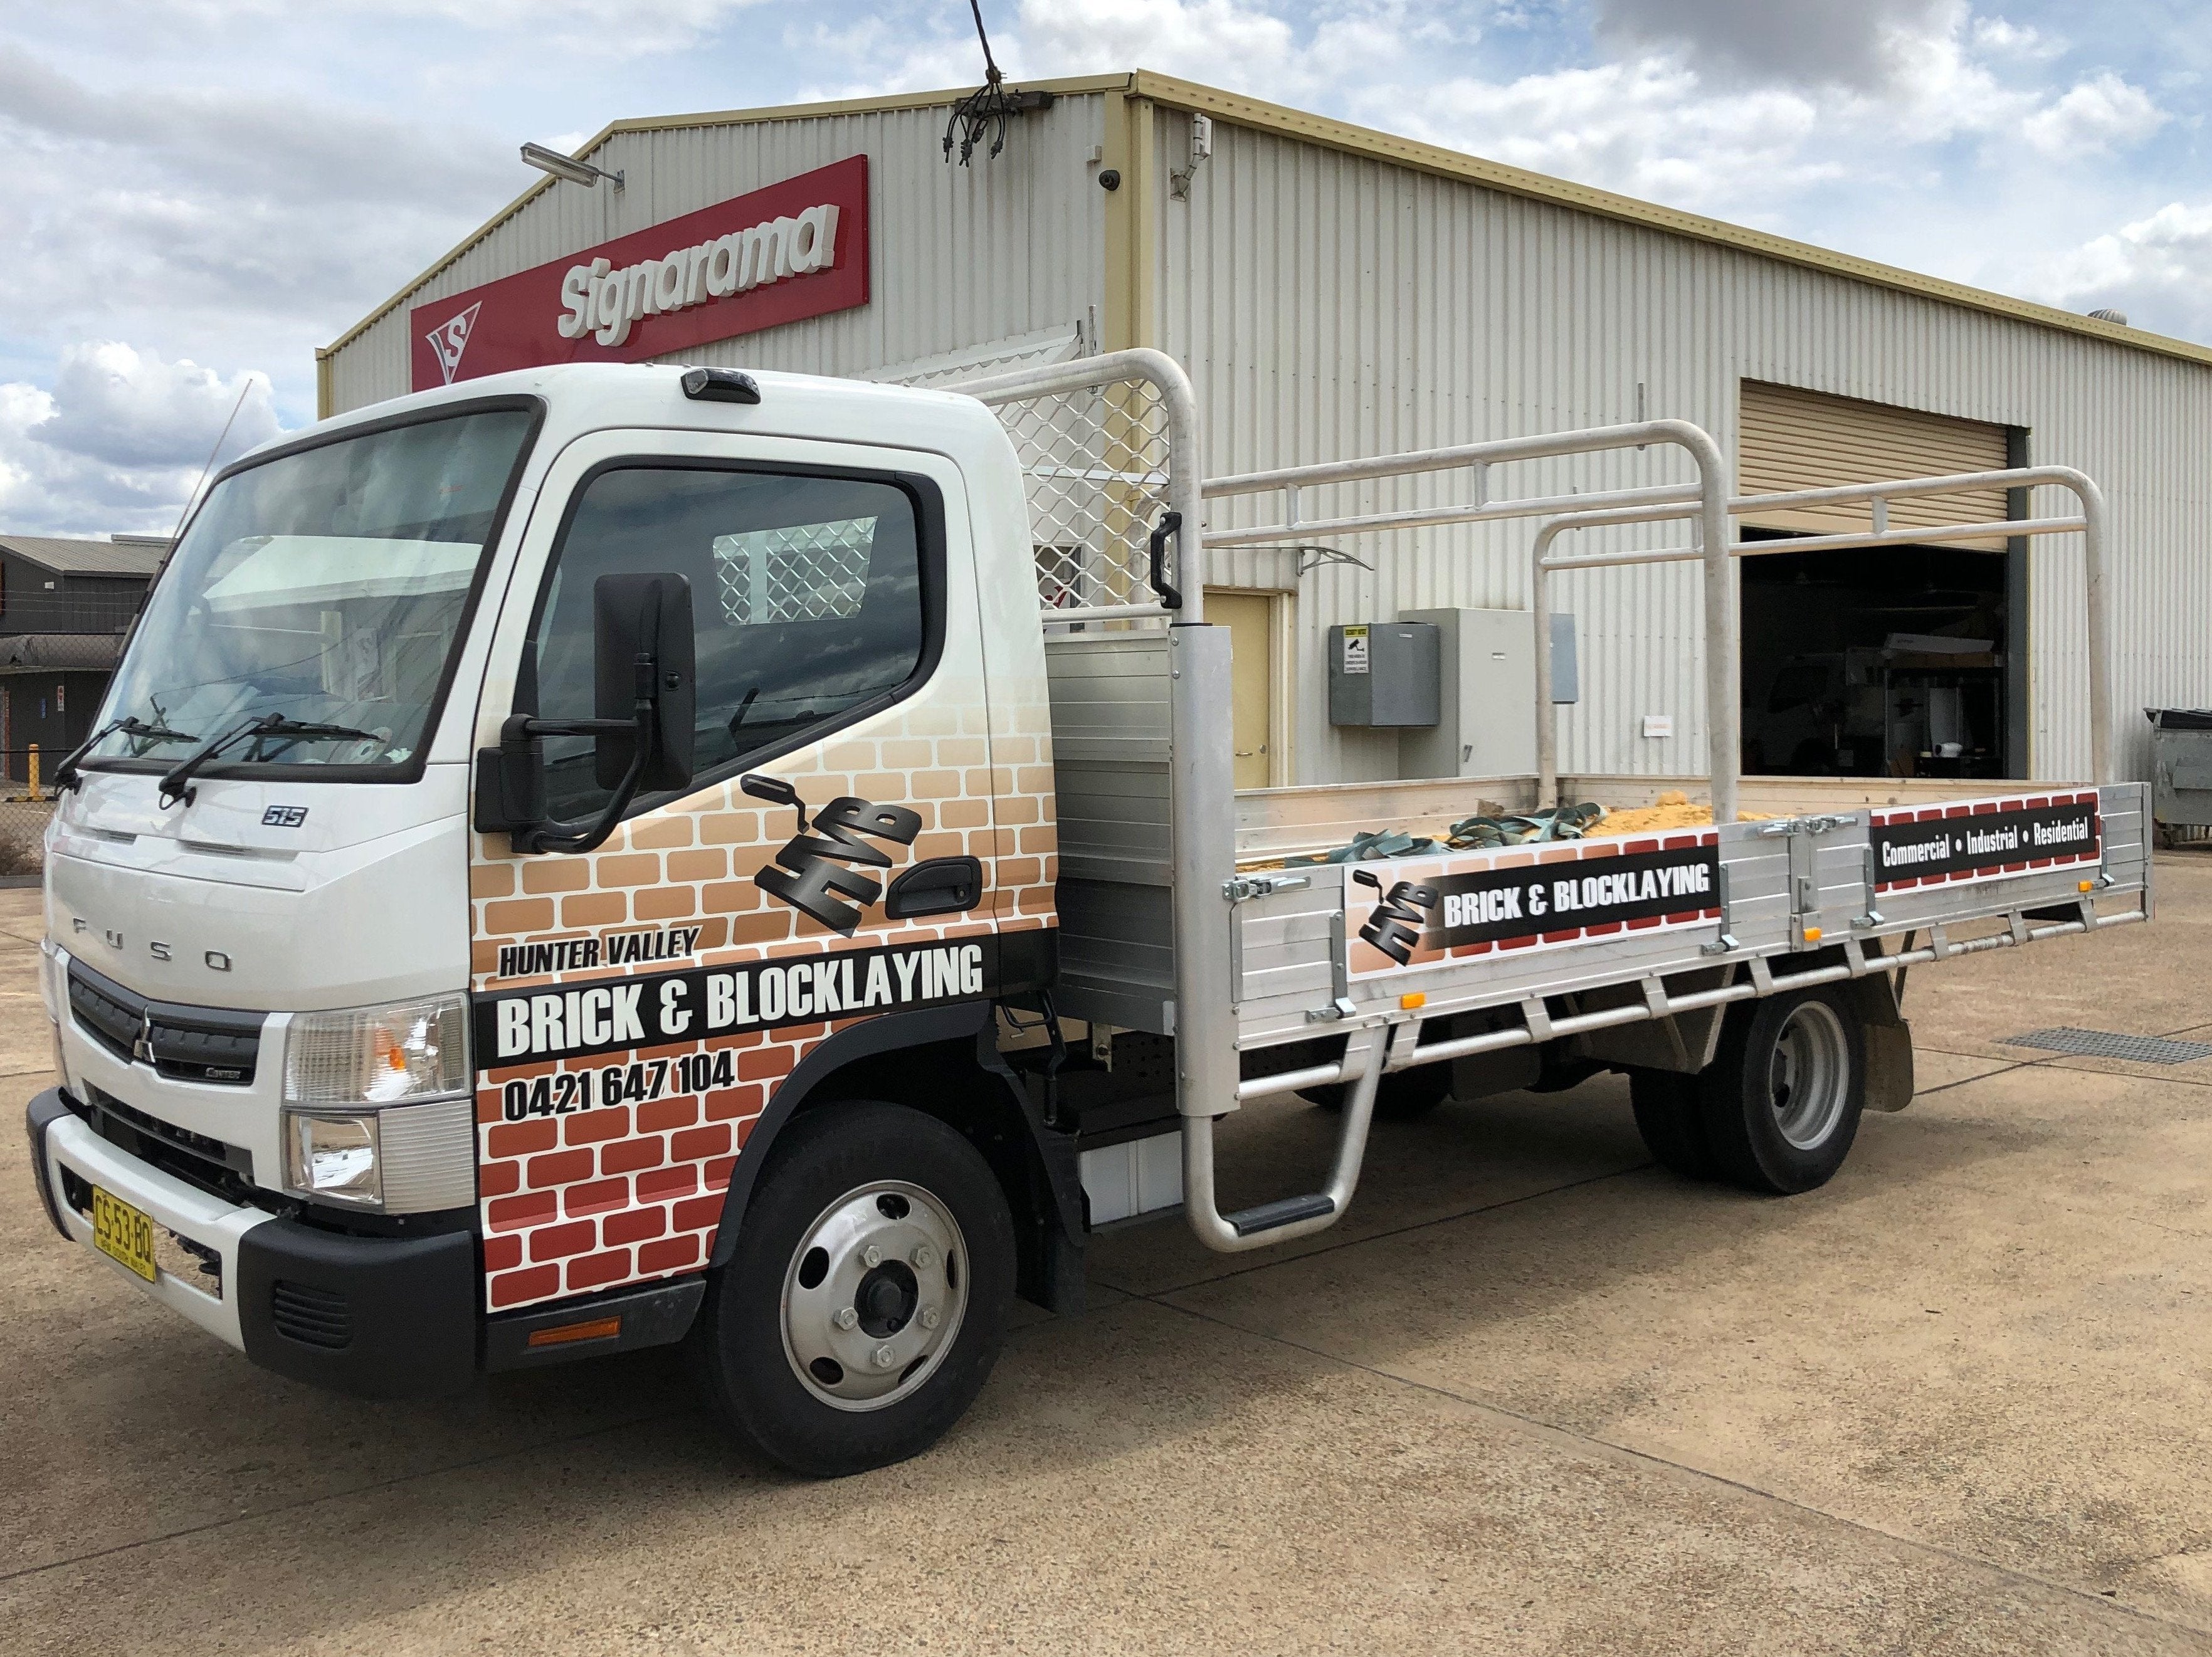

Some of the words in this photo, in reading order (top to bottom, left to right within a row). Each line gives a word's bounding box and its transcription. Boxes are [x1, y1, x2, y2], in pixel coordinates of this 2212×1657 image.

[558, 204, 840, 346] Signarama
[263, 807, 306, 825] 515
[1882, 833, 1950, 867] Commercial
[1966, 824, 2018, 855] Industrial
[2033, 816, 2088, 846] Residential
[1443, 887, 1522, 928] BRICK
[1529, 886, 1549, 915] &
[1554, 863, 1709, 912] BLOCKLAYING
[73, 917, 231, 972] FUSO
[500, 937, 599, 977] HUNTER
[608, 926, 700, 964] VALLEY
[498, 982, 644, 1058] BRICK
[660, 980, 692, 1035] &
[707, 944, 983, 1029] BLOCKLAYING
[504, 1071, 592, 1122] 0421
[601, 1060, 666, 1108] 647
[678, 1051, 735, 1095] 104
